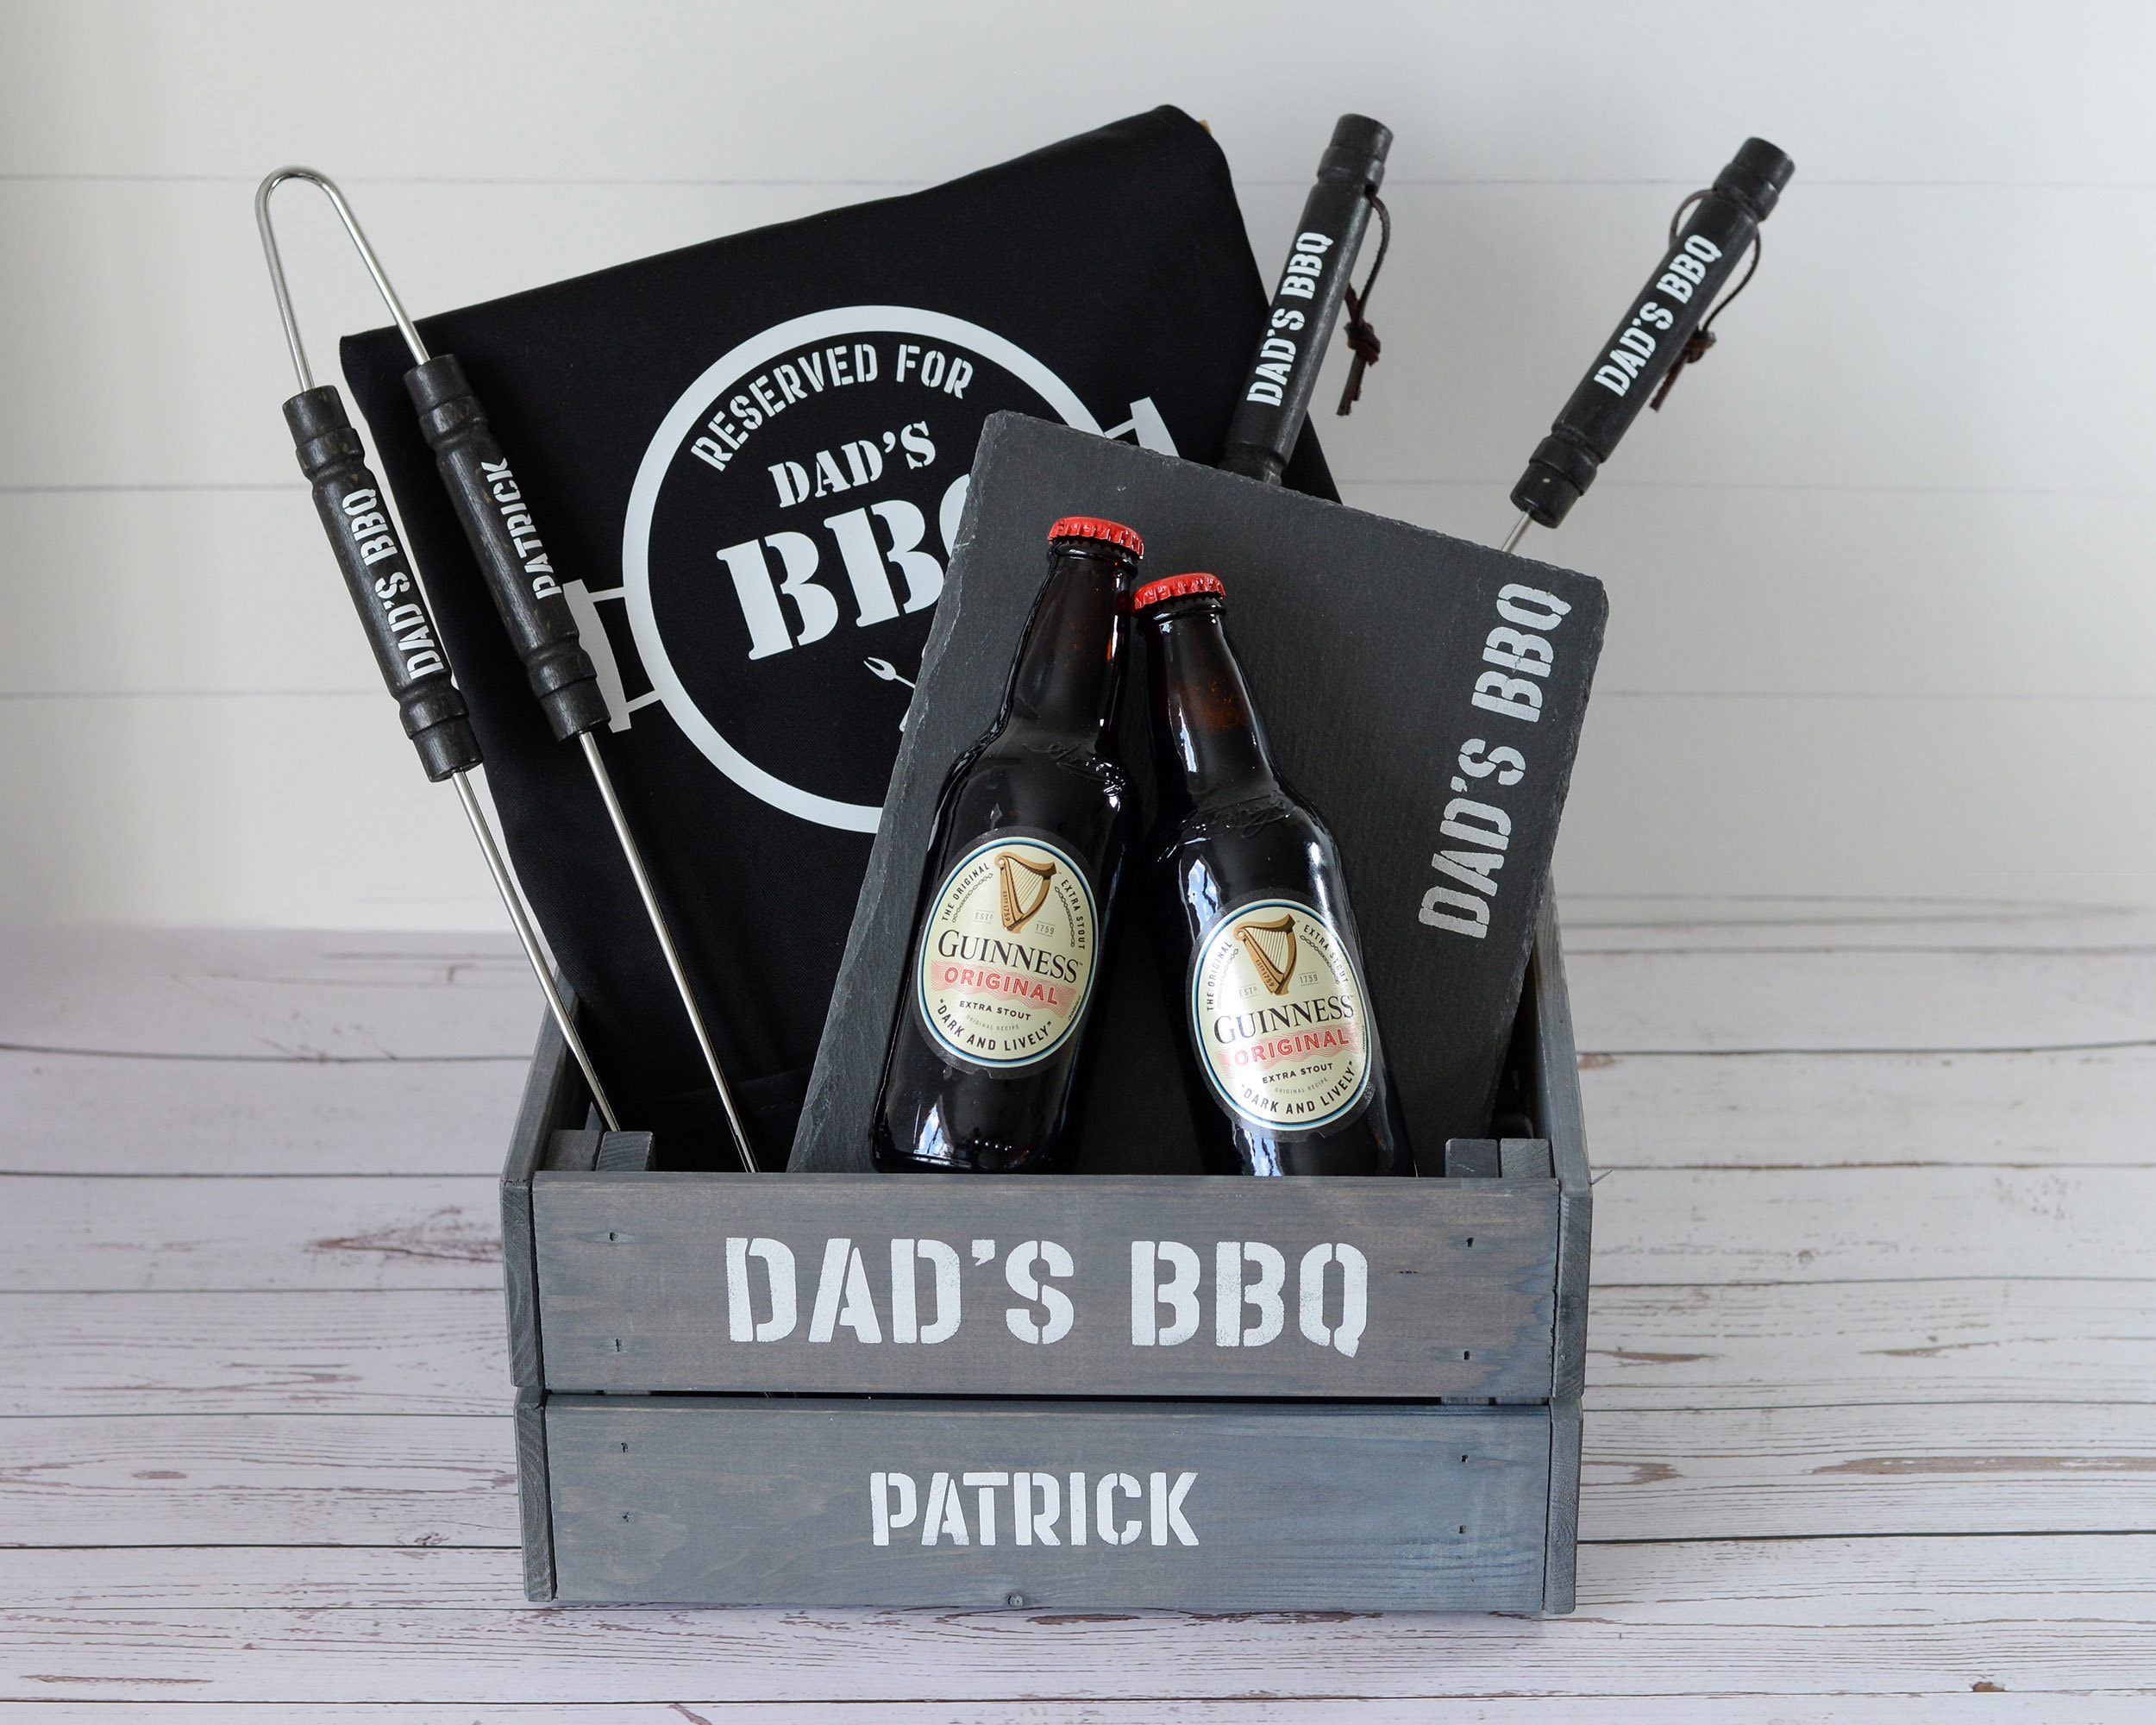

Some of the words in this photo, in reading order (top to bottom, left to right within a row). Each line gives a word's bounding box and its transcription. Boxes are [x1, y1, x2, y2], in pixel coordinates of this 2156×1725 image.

[1246, 308, 1306, 406] DAD'S
[1281, 231, 1334, 299] BBQ
[1593, 301, 1674, 397] DAD'S
[1656, 234, 1722, 304] BBQ
[691, 343, 878, 472] RESERVED
[896, 343, 974, 400] FOR
[768, 420, 937, 508] DAD'S
[342, 488, 398, 567] BBQ
[481, 458, 563, 599] PATRICK
[375, 571, 444, 680] DAD'S
[1471, 583, 1572, 723] BBQ
[1419, 738, 1526, 938] DAD'S
[942, 903, 954, 921] THE
[953, 862, 990, 900] ORIGINAL
[1062, 879, 1079, 912] EXTRA
[1076, 915, 1086, 950] STOUT
[938, 929, 1078, 983] GUINNESS
[1036, 924, 1055, 934] 1759
[1304, 925, 1330, 950] EXTRA
[1329, 951, 1349, 983] STOUT
[944, 967, 1057, 1005] ORIGINAL
[1208, 942, 1232, 987] ORIGINAL
[1300, 975, 1318, 984] 1759
[959, 1000, 993, 1013] EXTRA
[996, 1007, 1031, 1020] STOUT
[1213, 994, 1354, 1044] GUINNESS
[967, 1034, 996, 1051] AND
[1235, 1030, 1350, 1066] ORIGINAL
[1263, 1070, 1296, 1084] EXTRA
[1300, 1063, 1333, 1076] STOUT
[1286, 1101, 1315, 1114] AND
[725, 1237, 1075, 1345] DAD'S
[1131, 1240, 1369, 1358] BBQ
[869, 1471, 1200, 1546] PATRICK
